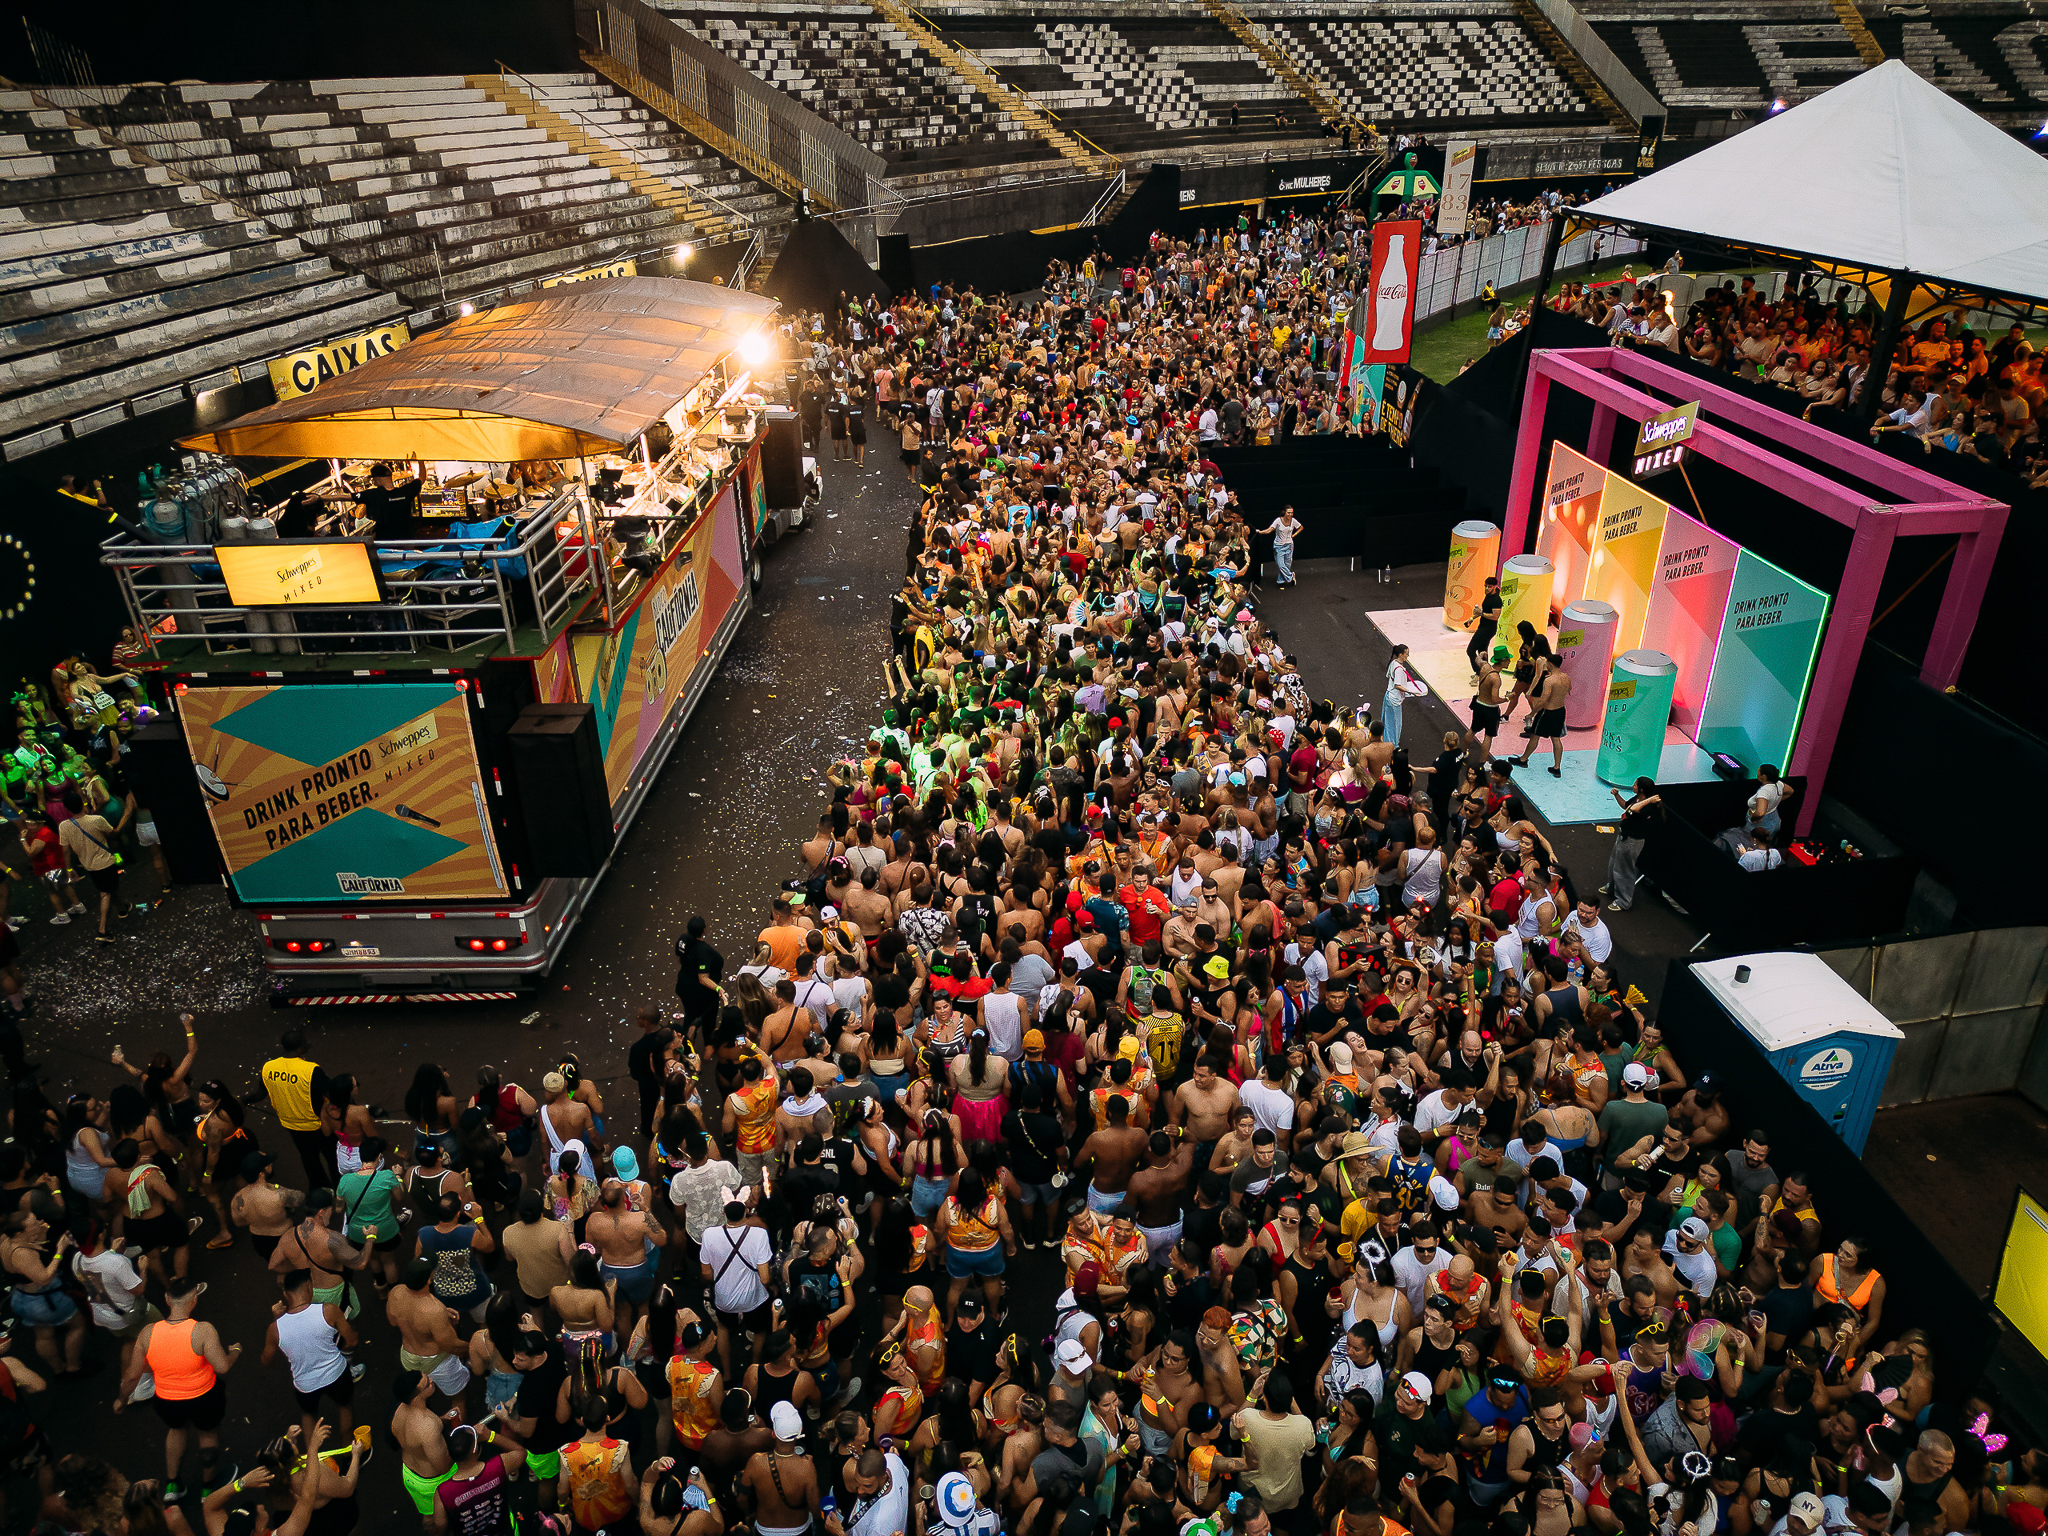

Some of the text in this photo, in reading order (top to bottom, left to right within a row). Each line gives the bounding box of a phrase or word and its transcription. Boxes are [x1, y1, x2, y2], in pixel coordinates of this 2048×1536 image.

[1293, 175, 1331, 190] MULHERES
[292, 333, 397, 393] CAIXAS
[1641, 416, 1688, 444] Schweppes
[1634, 445, 1684, 475] MIXED
[1565, 472, 1585, 489] PRONTO
[1552, 492, 1565, 506] PARA
[1602, 505, 1643, 529] DRINK PRONTO
[1604, 527, 1619, 542] PARA
[1663, 544, 1710, 567] DRINK PRONTO
[276, 556, 317, 584] Schweppes
[1664, 561, 1704, 581] PARA BEBER.
[283, 575, 323, 603] MIXED
[1733, 592, 1790, 614] DRINK PRONTO
[1735, 610, 1783, 630] PARA BEBER.
[378, 723, 431, 759] Schweppes
[384, 749, 436, 783] MIXED
[242, 748, 372, 831] DRINK PRONTO
[264, 780, 380, 850] PARA BEBER.
[268, 1070, 298, 1085] APOIO
[1811, 1062, 1844, 1071] Ativa
[1802, 1500, 1816, 1513] NY
